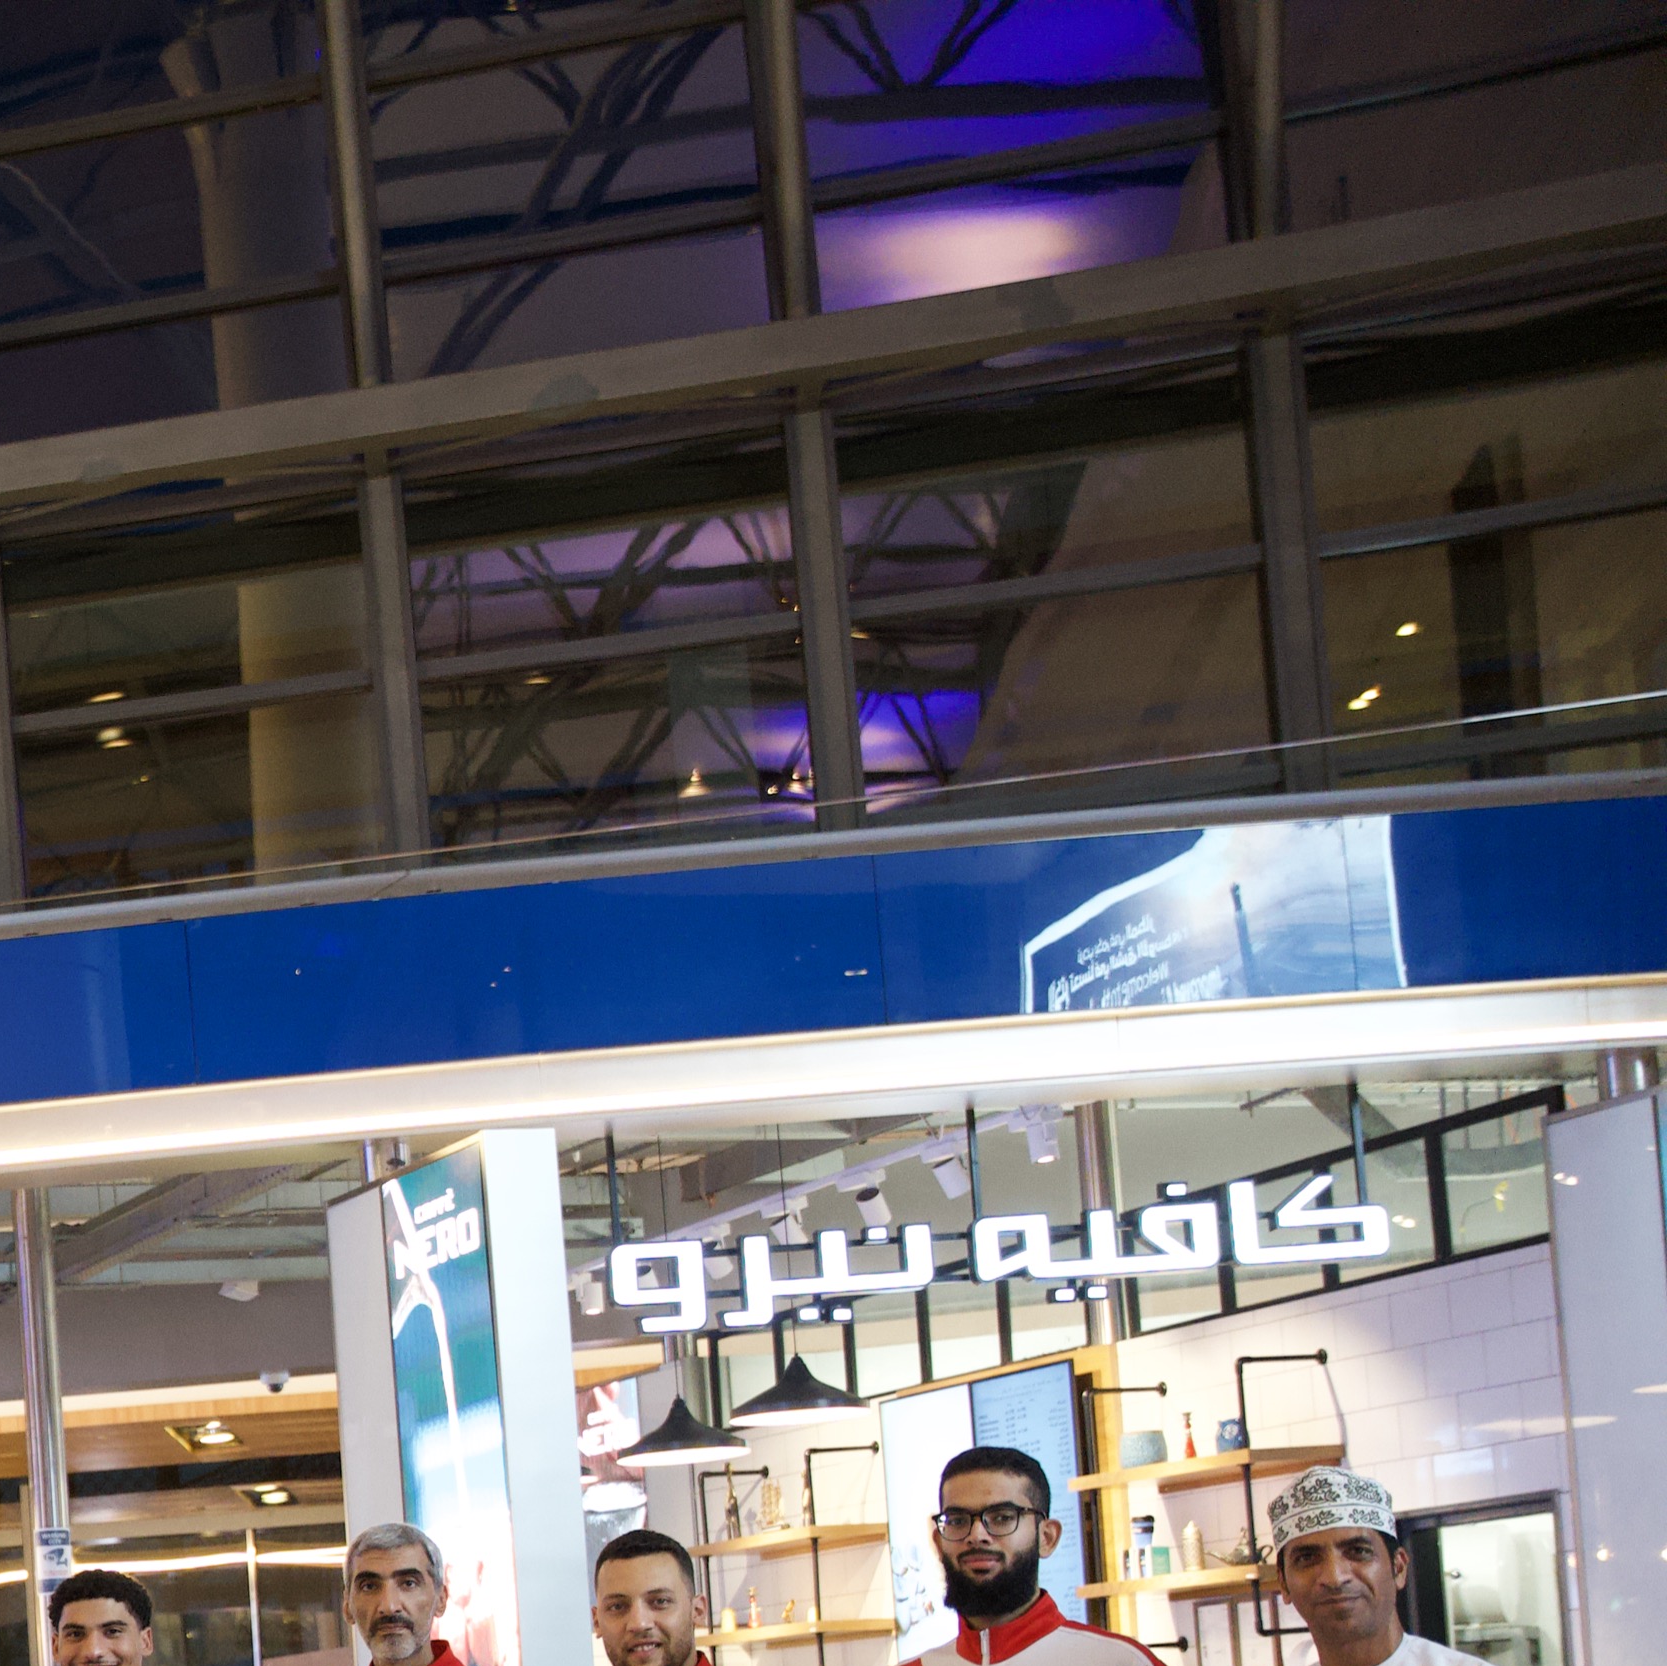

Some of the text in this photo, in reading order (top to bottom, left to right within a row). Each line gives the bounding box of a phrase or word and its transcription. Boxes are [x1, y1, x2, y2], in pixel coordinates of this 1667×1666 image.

[393, 1207, 481, 1280] NERO
[607, 1173, 1391, 1334] كافيه نيرو
